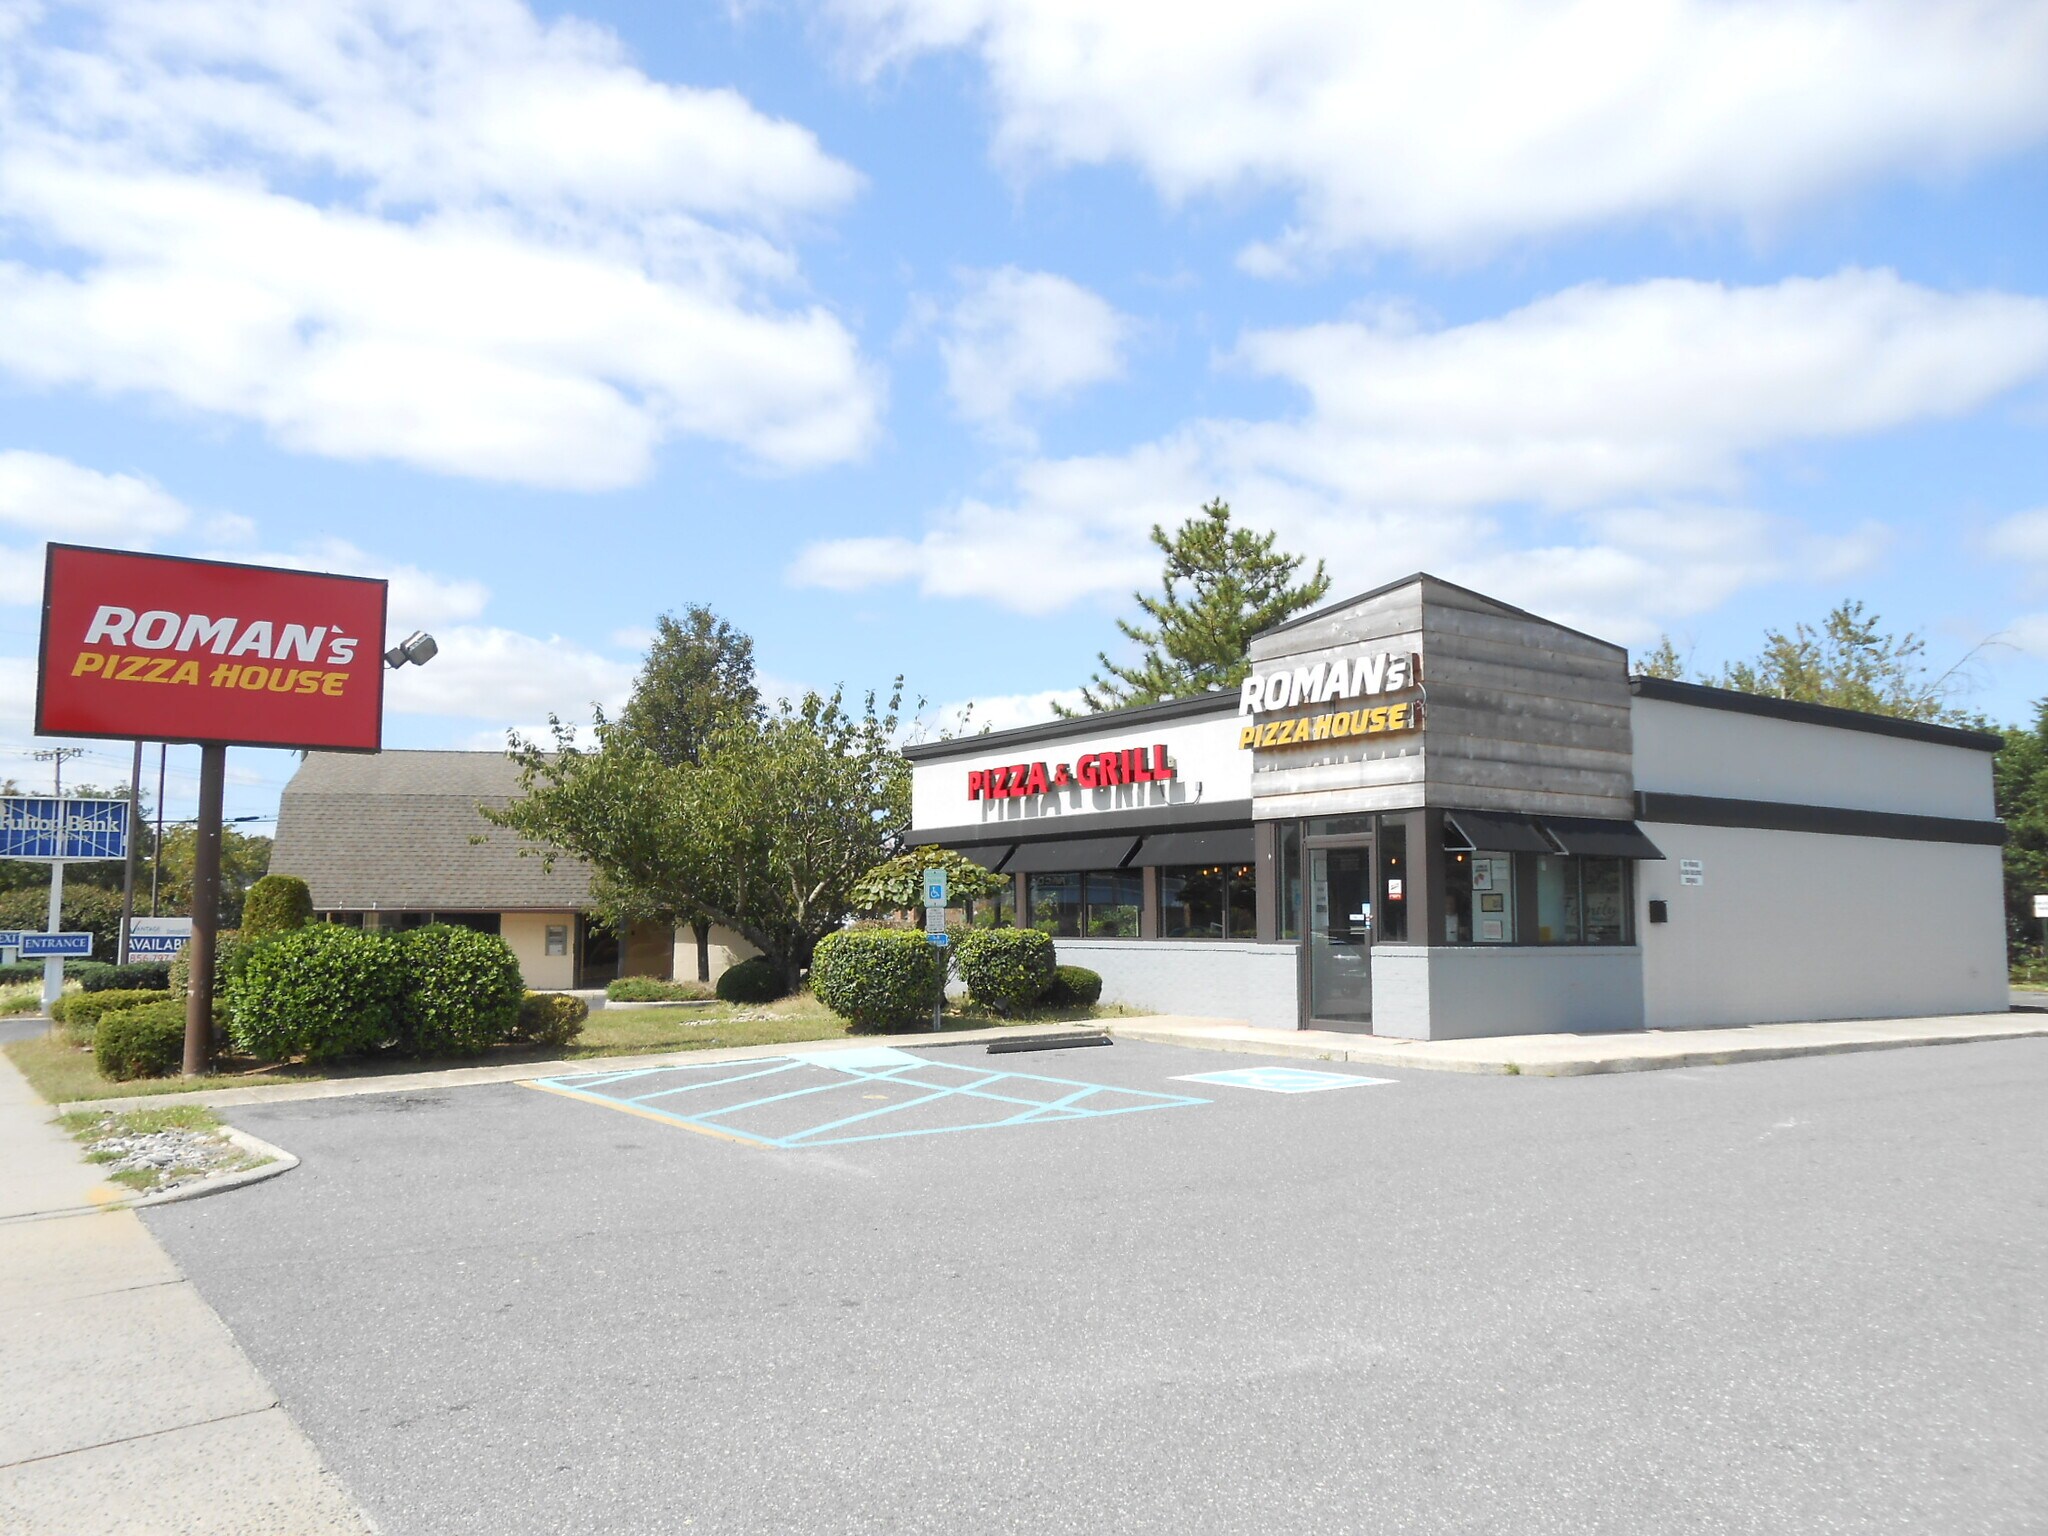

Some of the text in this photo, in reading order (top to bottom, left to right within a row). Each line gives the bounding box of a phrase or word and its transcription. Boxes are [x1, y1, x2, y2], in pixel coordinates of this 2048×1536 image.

[71, 652, 350, 696] PIZZA HOUSE
[1238, 702, 1408, 750] PIZZA HOUSE
[968, 744, 1173, 800] PIZZA & GRILL
[67, 815, 120, 833] Bank
[0, 934, 17, 944] EXI
[25, 938, 87, 949] ENTRANCE
[129, 938, 187, 951] AVAILAB
